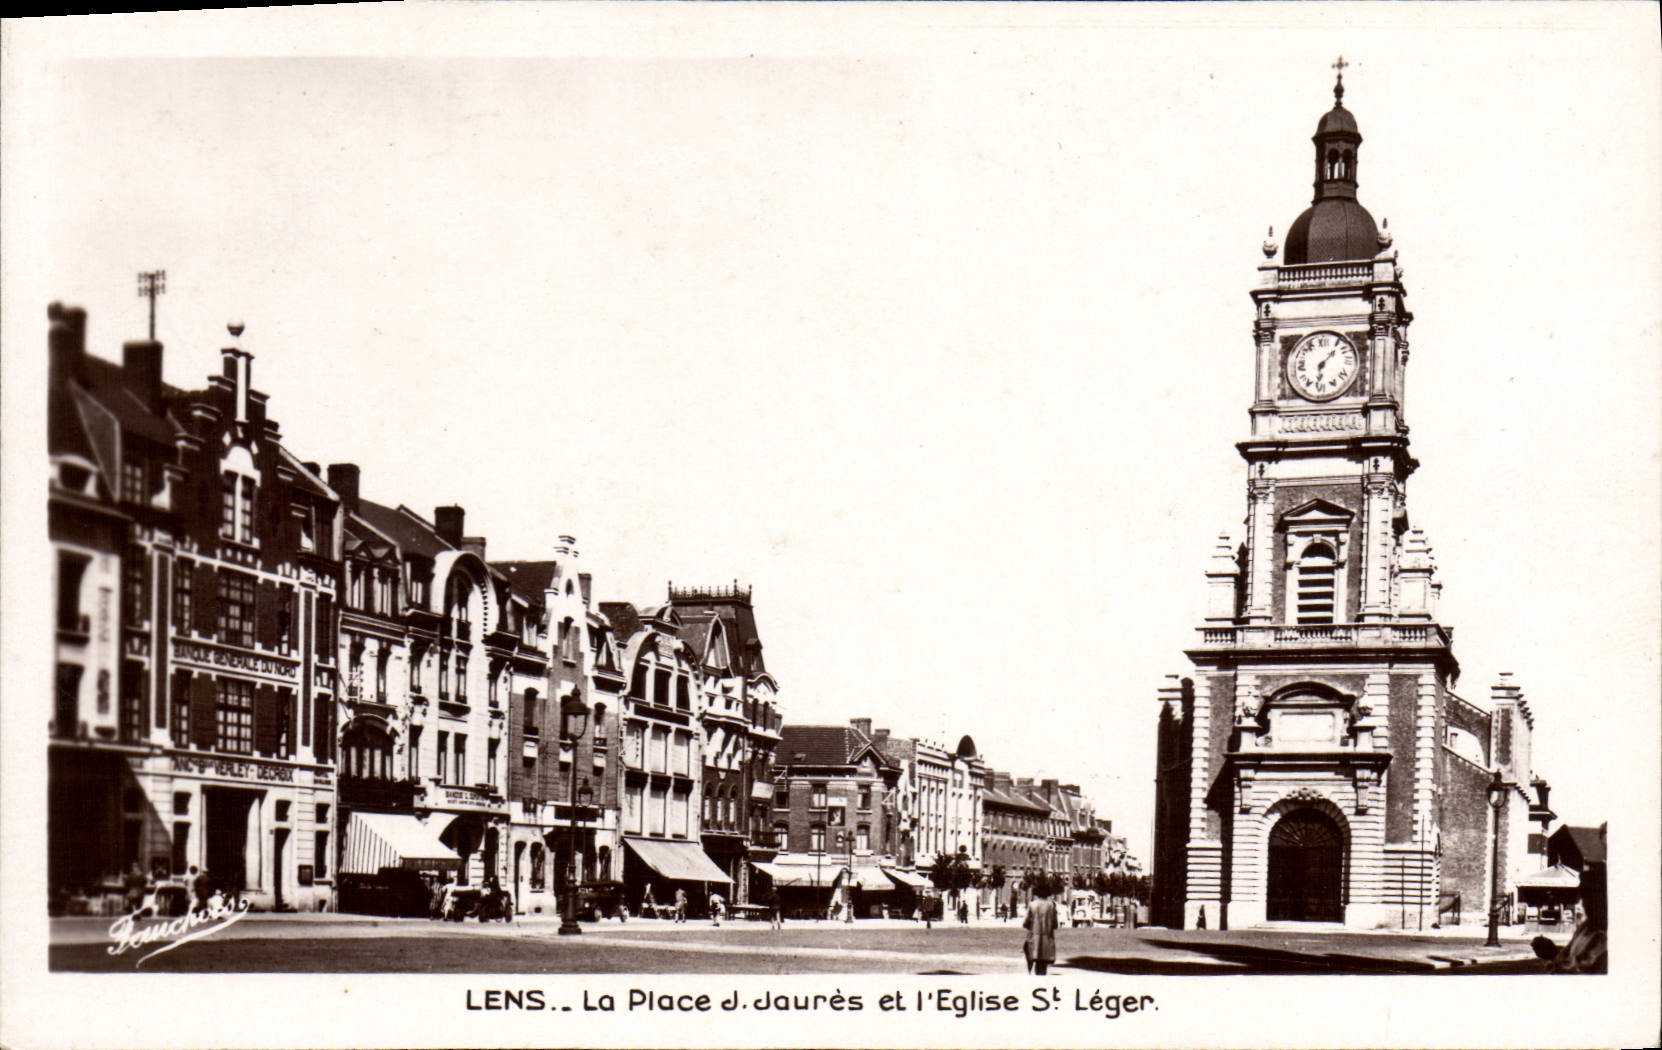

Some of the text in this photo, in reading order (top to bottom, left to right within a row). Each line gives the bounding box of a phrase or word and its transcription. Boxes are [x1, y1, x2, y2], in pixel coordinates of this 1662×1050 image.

[173, 644, 211, 663] BANQUE
[260, 660, 272, 674] DU
[274, 662, 297, 679] NORD
